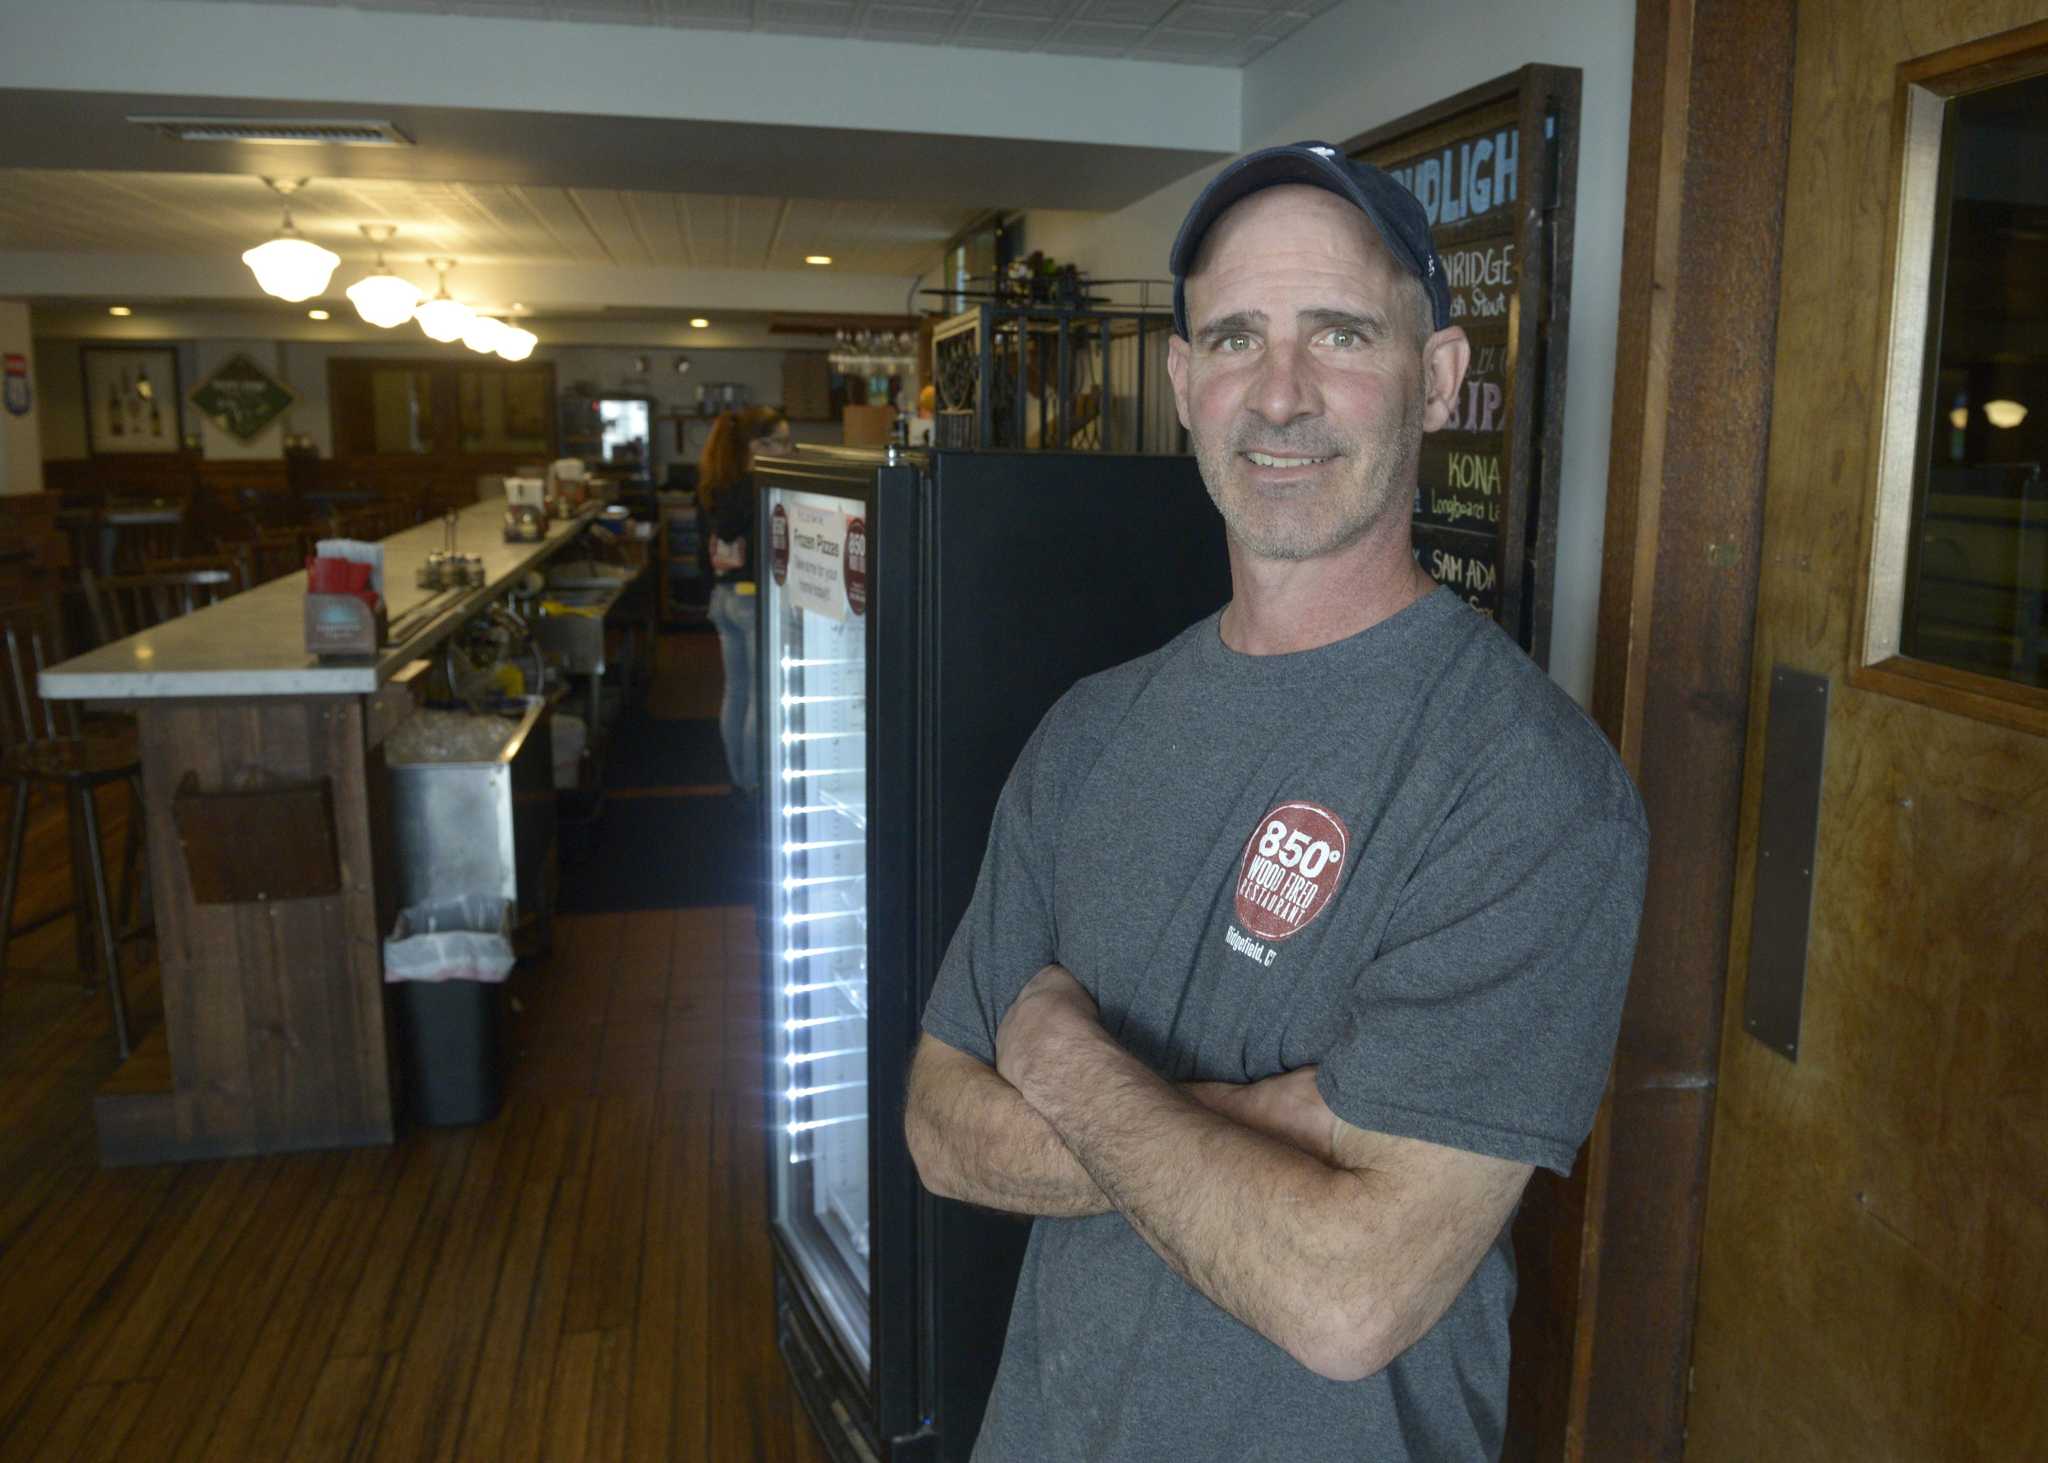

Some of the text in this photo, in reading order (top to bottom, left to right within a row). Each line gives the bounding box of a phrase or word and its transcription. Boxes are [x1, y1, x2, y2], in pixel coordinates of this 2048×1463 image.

[1448, 453, 1502, 496] KONA
[1431, 549, 1462, 582] SAM
[1258, 820, 1341, 878] 850°
[1239, 878, 1306, 927] RESTAURANT
[1247, 854, 1318, 909] WOOD FIRED
[1225, 925, 1277, 967] Ridgefield, CT
